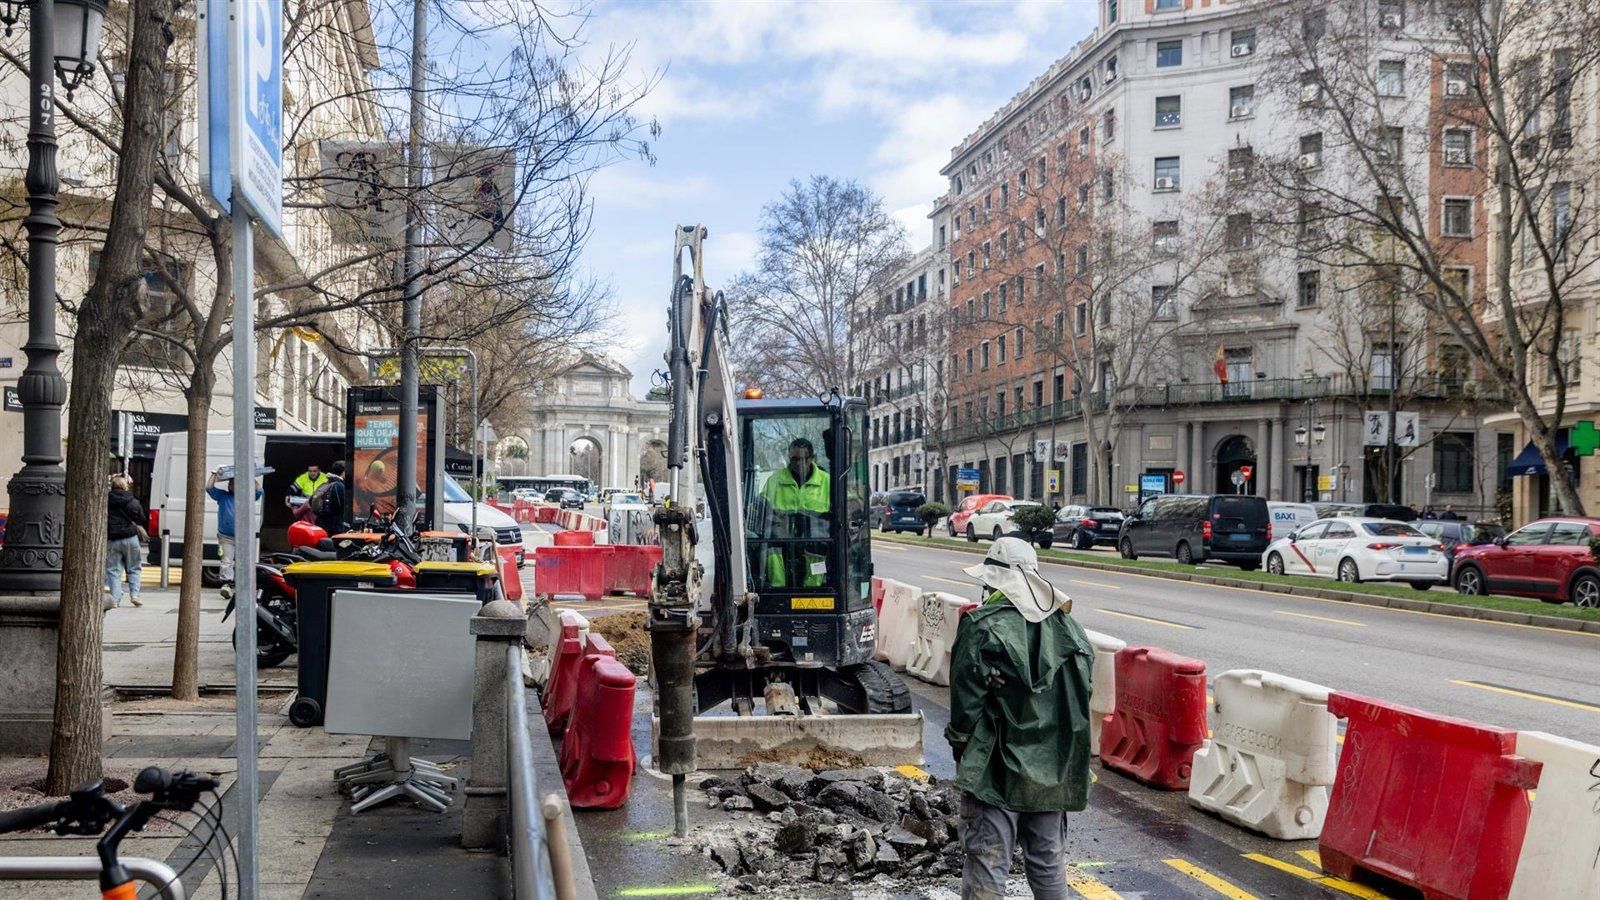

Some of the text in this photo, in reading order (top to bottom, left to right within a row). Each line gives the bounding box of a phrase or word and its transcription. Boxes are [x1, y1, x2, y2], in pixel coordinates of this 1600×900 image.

[40, 83, 51, 125] 207
[132, 414, 146, 423] ASA
[132, 424, 161, 434] ARMEN
[368, 420, 393, 429] TENIS
[356, 429, 398, 437] QUE DEJA
[356, 437, 389, 446] HUELLA
[1274, 512, 1296, 520] BAXI
